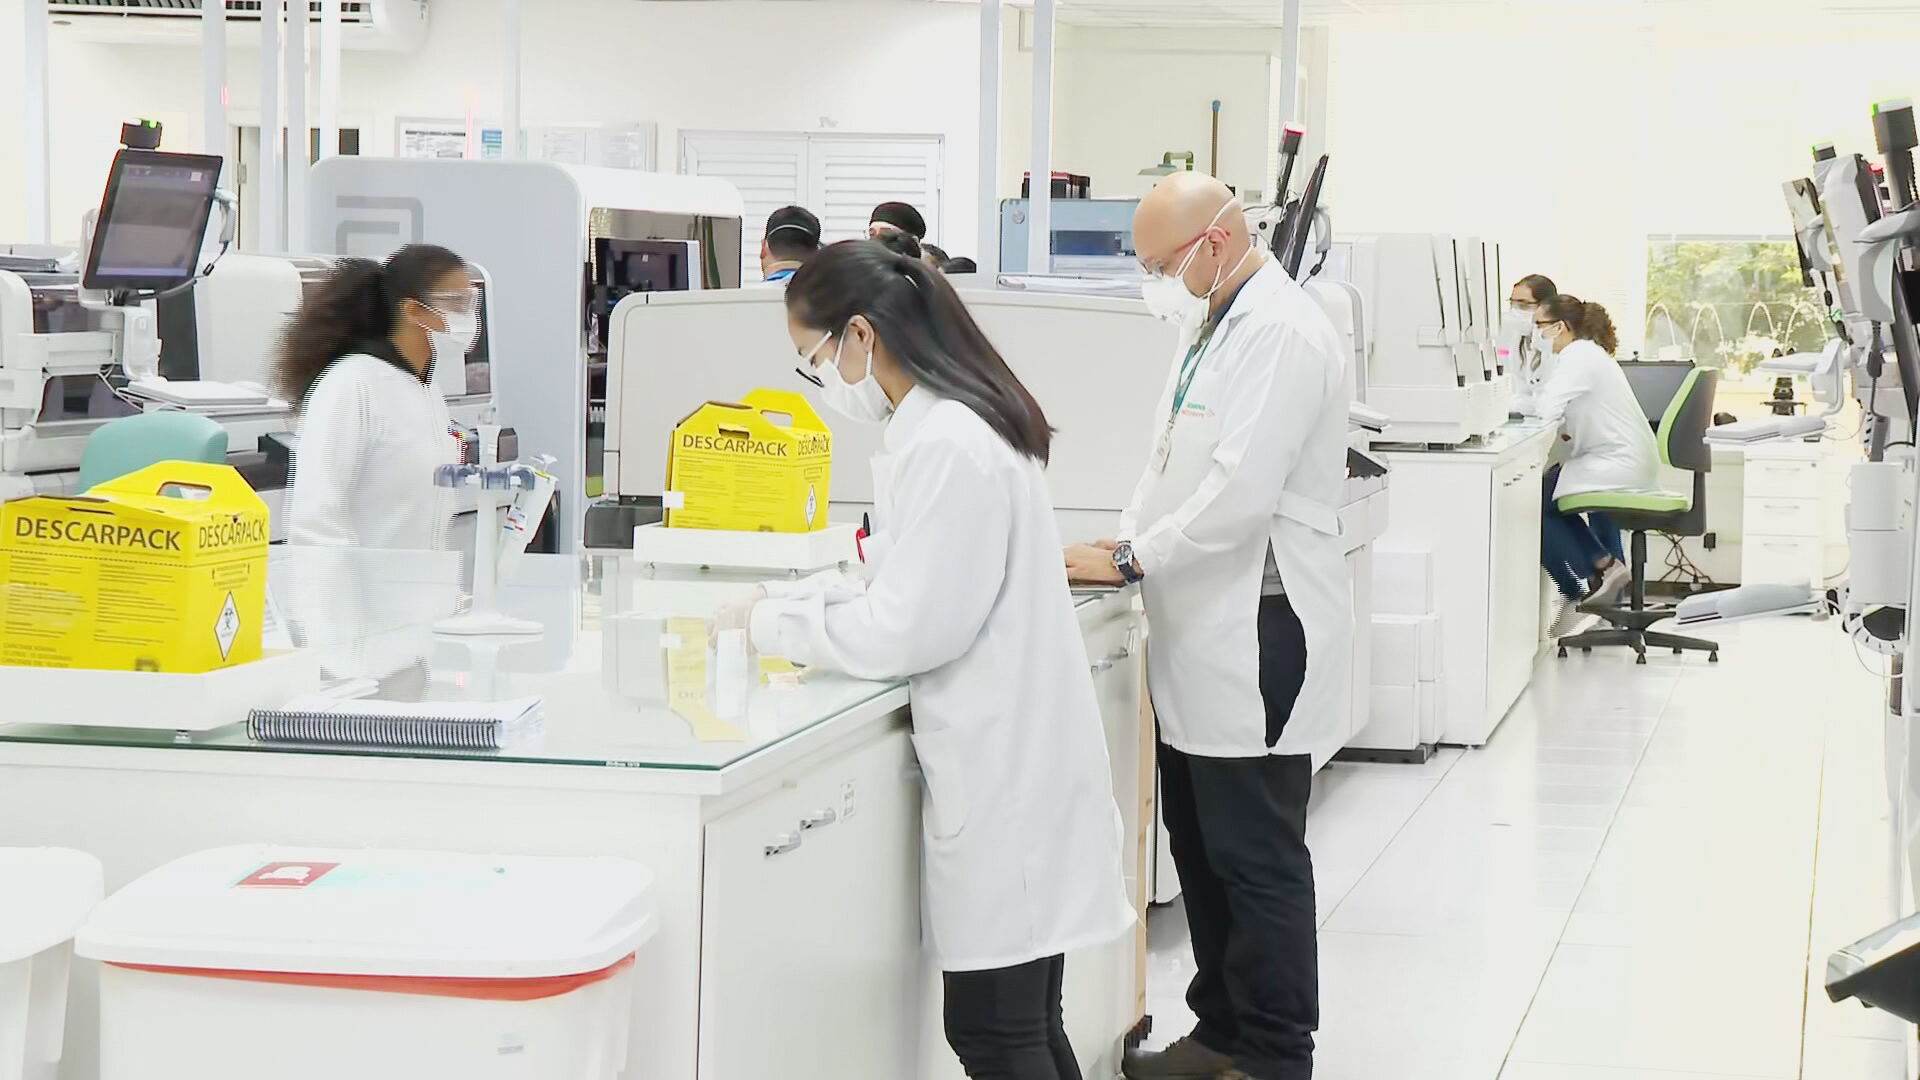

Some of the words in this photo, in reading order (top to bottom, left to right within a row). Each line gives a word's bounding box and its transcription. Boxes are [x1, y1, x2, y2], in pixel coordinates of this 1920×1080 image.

[683, 434, 787, 456] DESCARPACK
[16, 516, 181, 551] DESCARPACK
[200, 518, 266, 549] DESCARPACK
